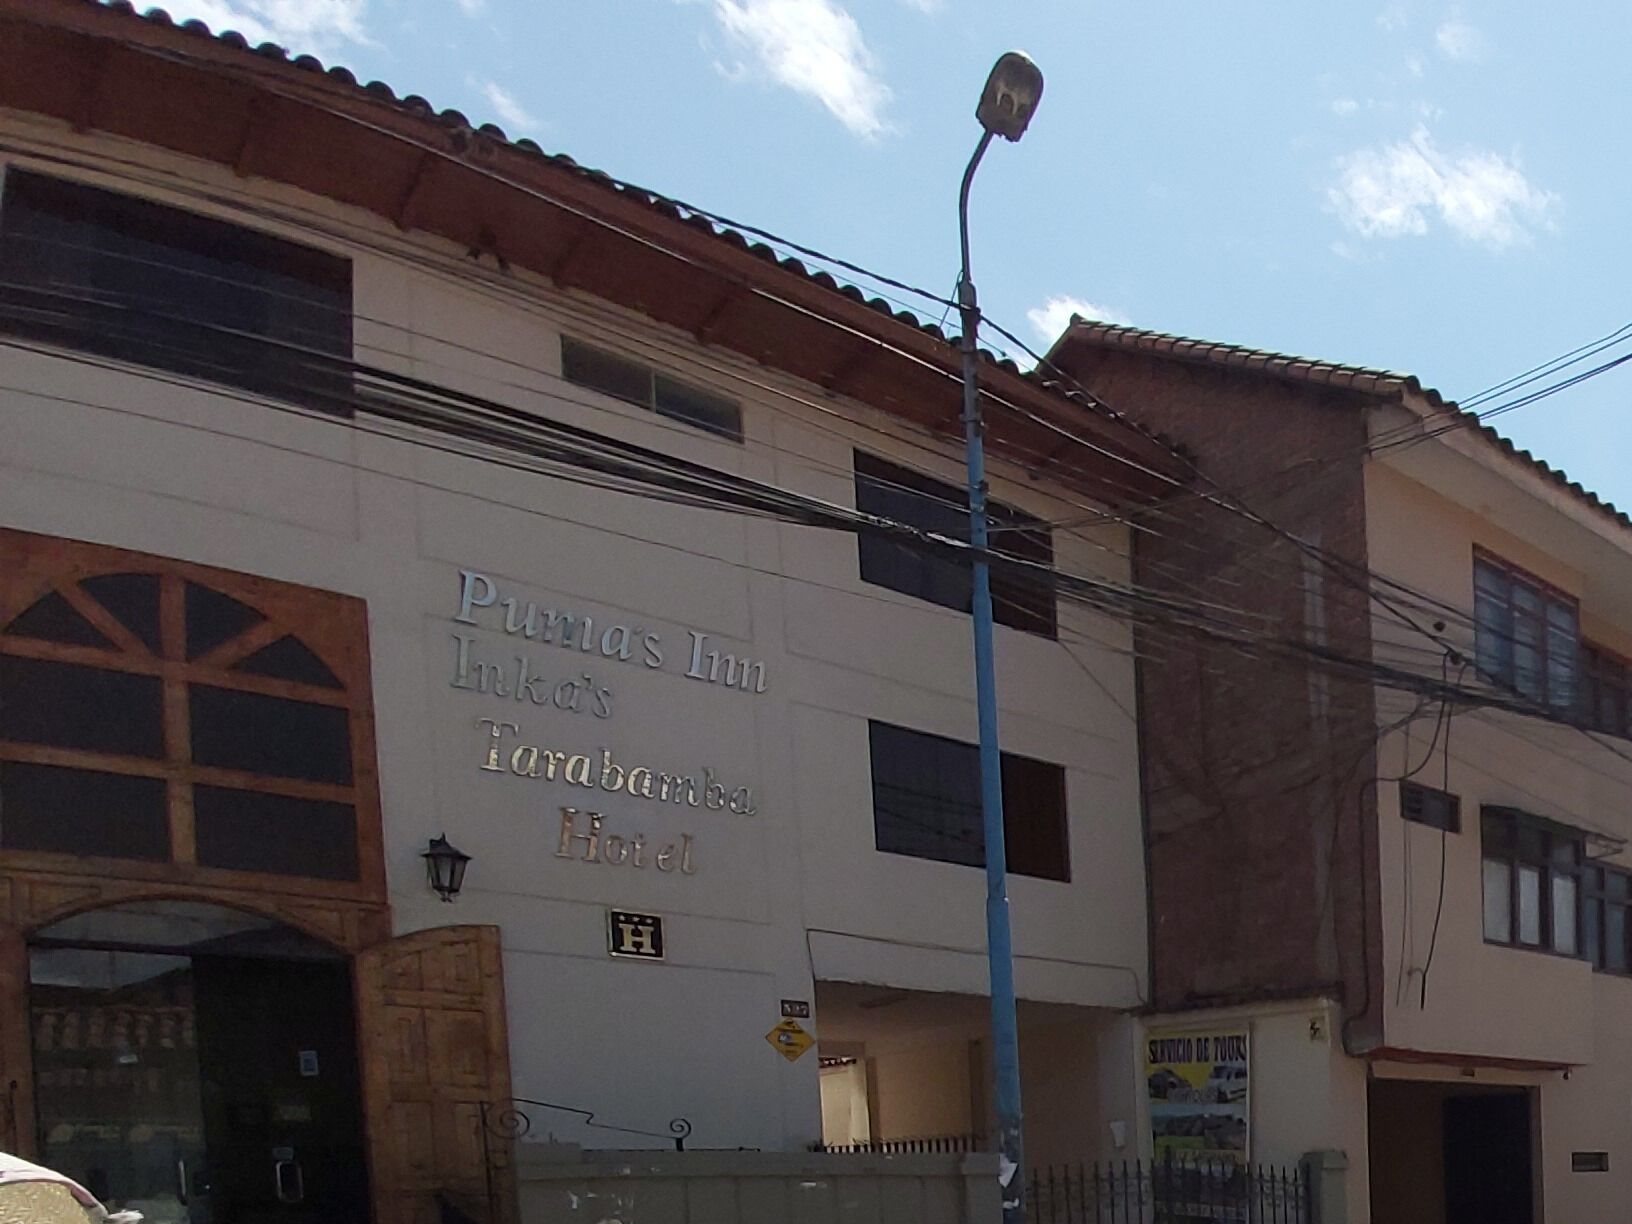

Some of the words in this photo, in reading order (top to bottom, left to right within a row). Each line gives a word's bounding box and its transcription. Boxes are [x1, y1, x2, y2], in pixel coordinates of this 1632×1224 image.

[454, 568, 665, 669] Puma's
[685, 630, 768, 693] Inn
[449, 633, 613, 719] Inka's
[476, 717, 757, 817] Tarabamba
[553, 805, 697, 875] Hotel
[618, 922, 656, 954] H
[1149, 1038, 1192, 1064] SERVICIO
[1196, 1037, 1209, 1062] DE
